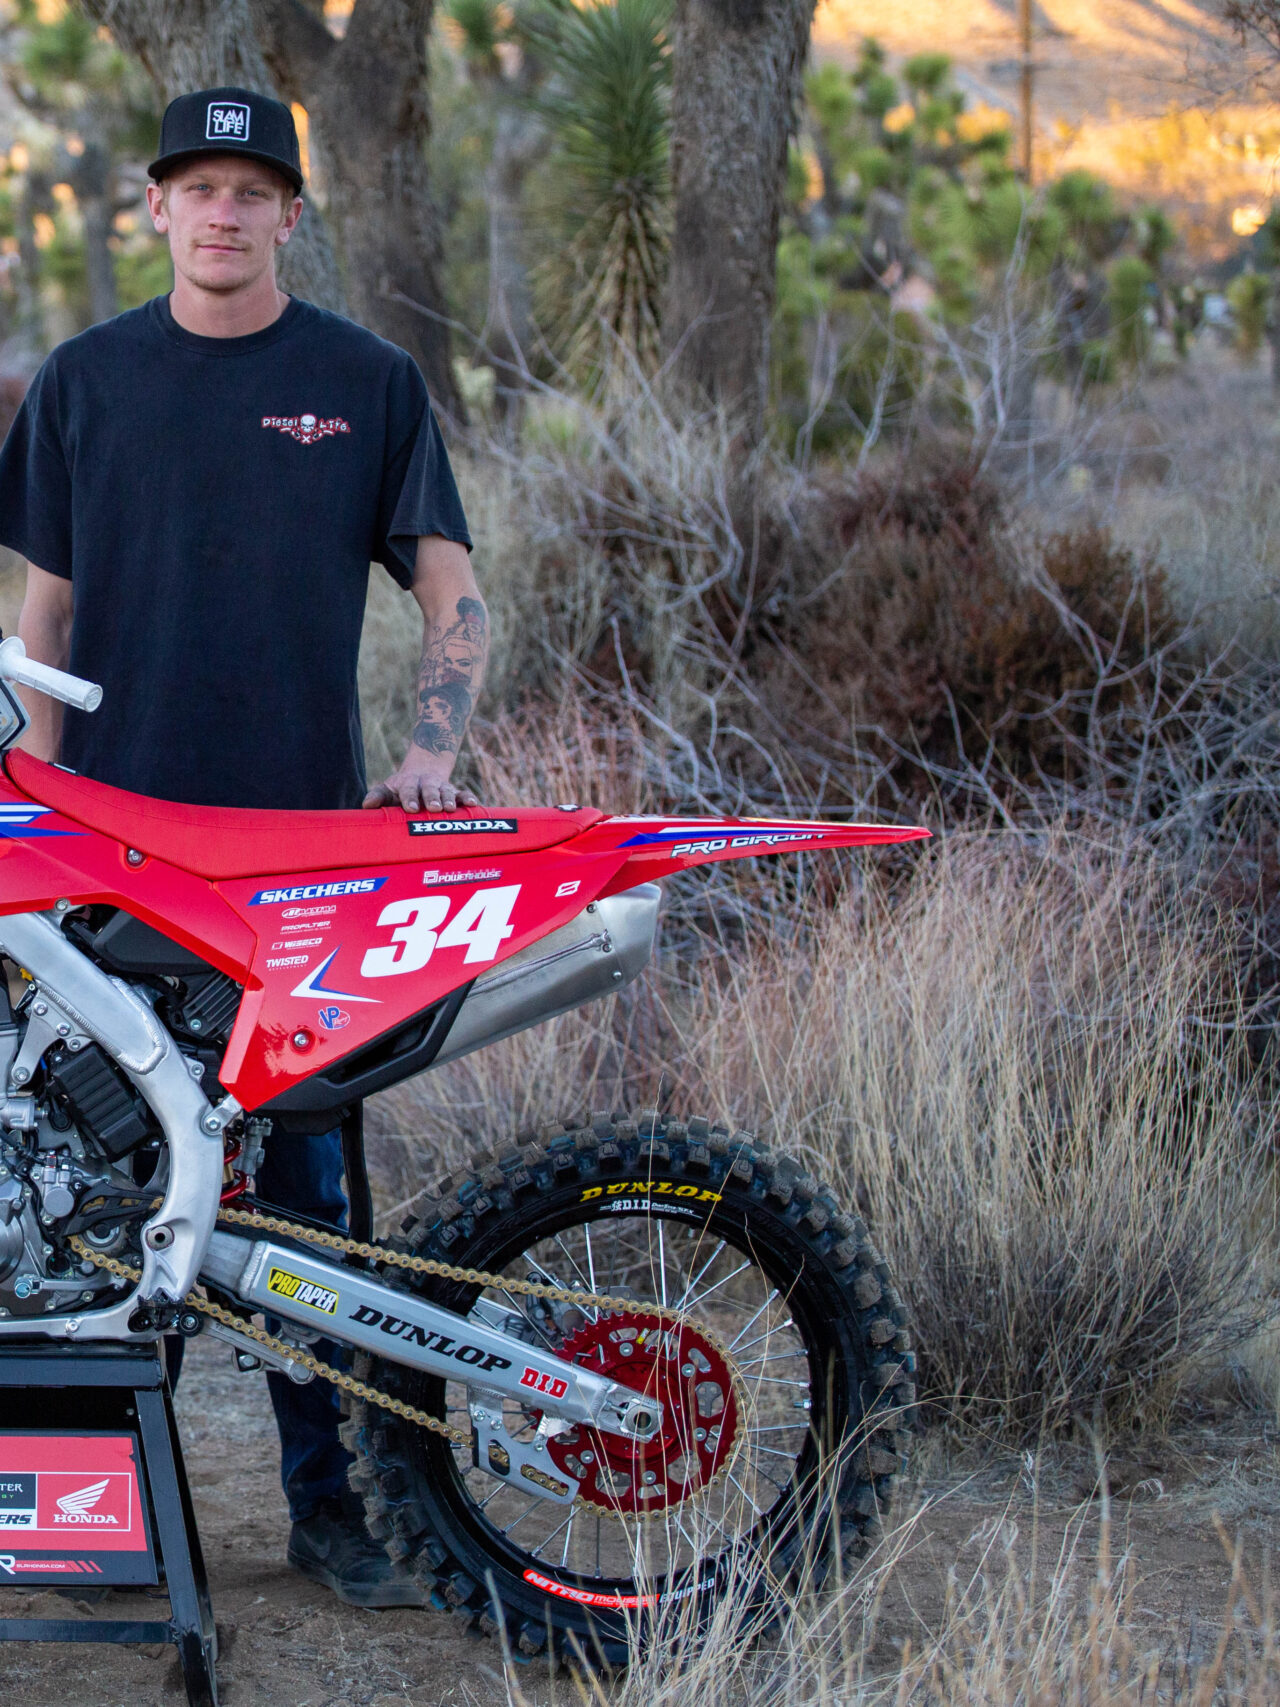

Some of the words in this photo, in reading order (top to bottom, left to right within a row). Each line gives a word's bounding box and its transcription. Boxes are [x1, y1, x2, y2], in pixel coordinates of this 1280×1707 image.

[212, 109, 244, 125] SLAM
[214, 120, 243, 135] LIFE
[412, 819, 514, 833] HONDA
[671, 838, 728, 858] PRO
[259, 879, 376, 904] SKECHERS
[360, 883, 522, 978] 34
[266, 954, 309, 969] TWISTED
[318, 1005, 340, 1030] VP
[579, 1181, 723, 1203] DUNLOP
[271, 1271, 338, 1315] PROTAPER
[349, 1304, 513, 1373] DUNLOP
[520, 1367, 569, 1399] D.I.D
[53, 1514, 119, 1524] HONDA
[526, 1572, 595, 1602] NITRO
